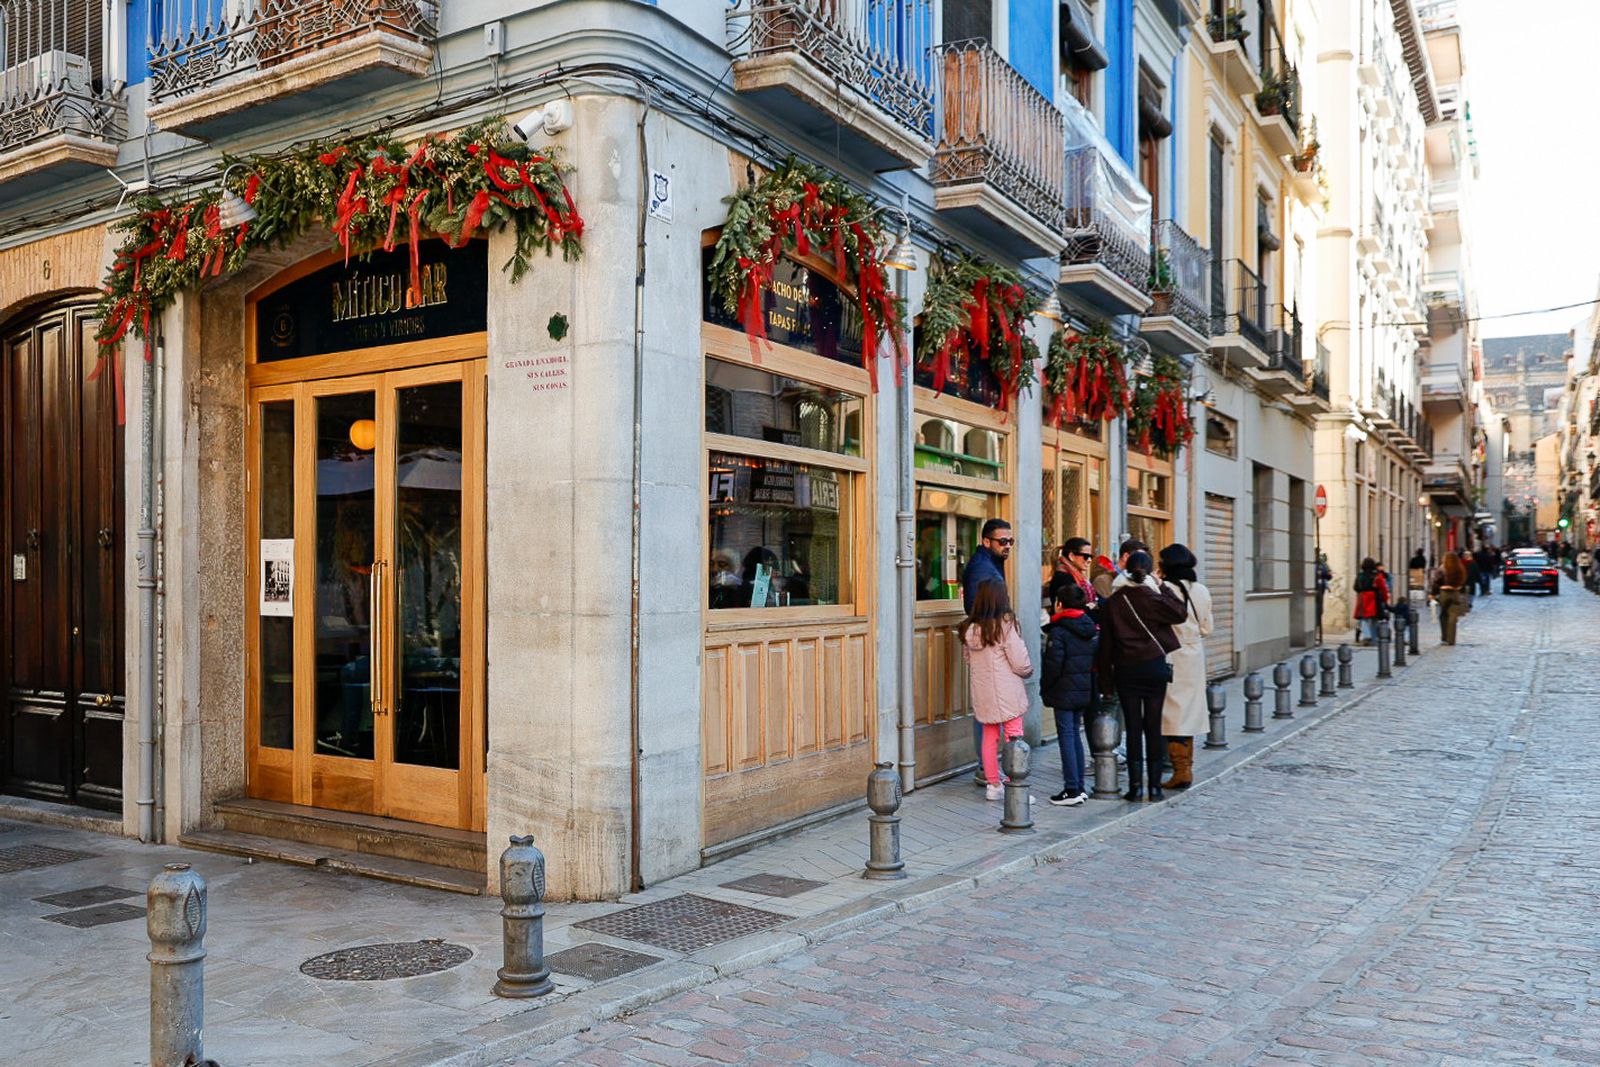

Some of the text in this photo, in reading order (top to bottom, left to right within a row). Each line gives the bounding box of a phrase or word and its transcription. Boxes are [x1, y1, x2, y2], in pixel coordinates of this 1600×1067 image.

[43, 259, 51, 280] 6
[332, 271, 401, 322] MÍTICO
[768, 310, 791, 332] TAPAS
